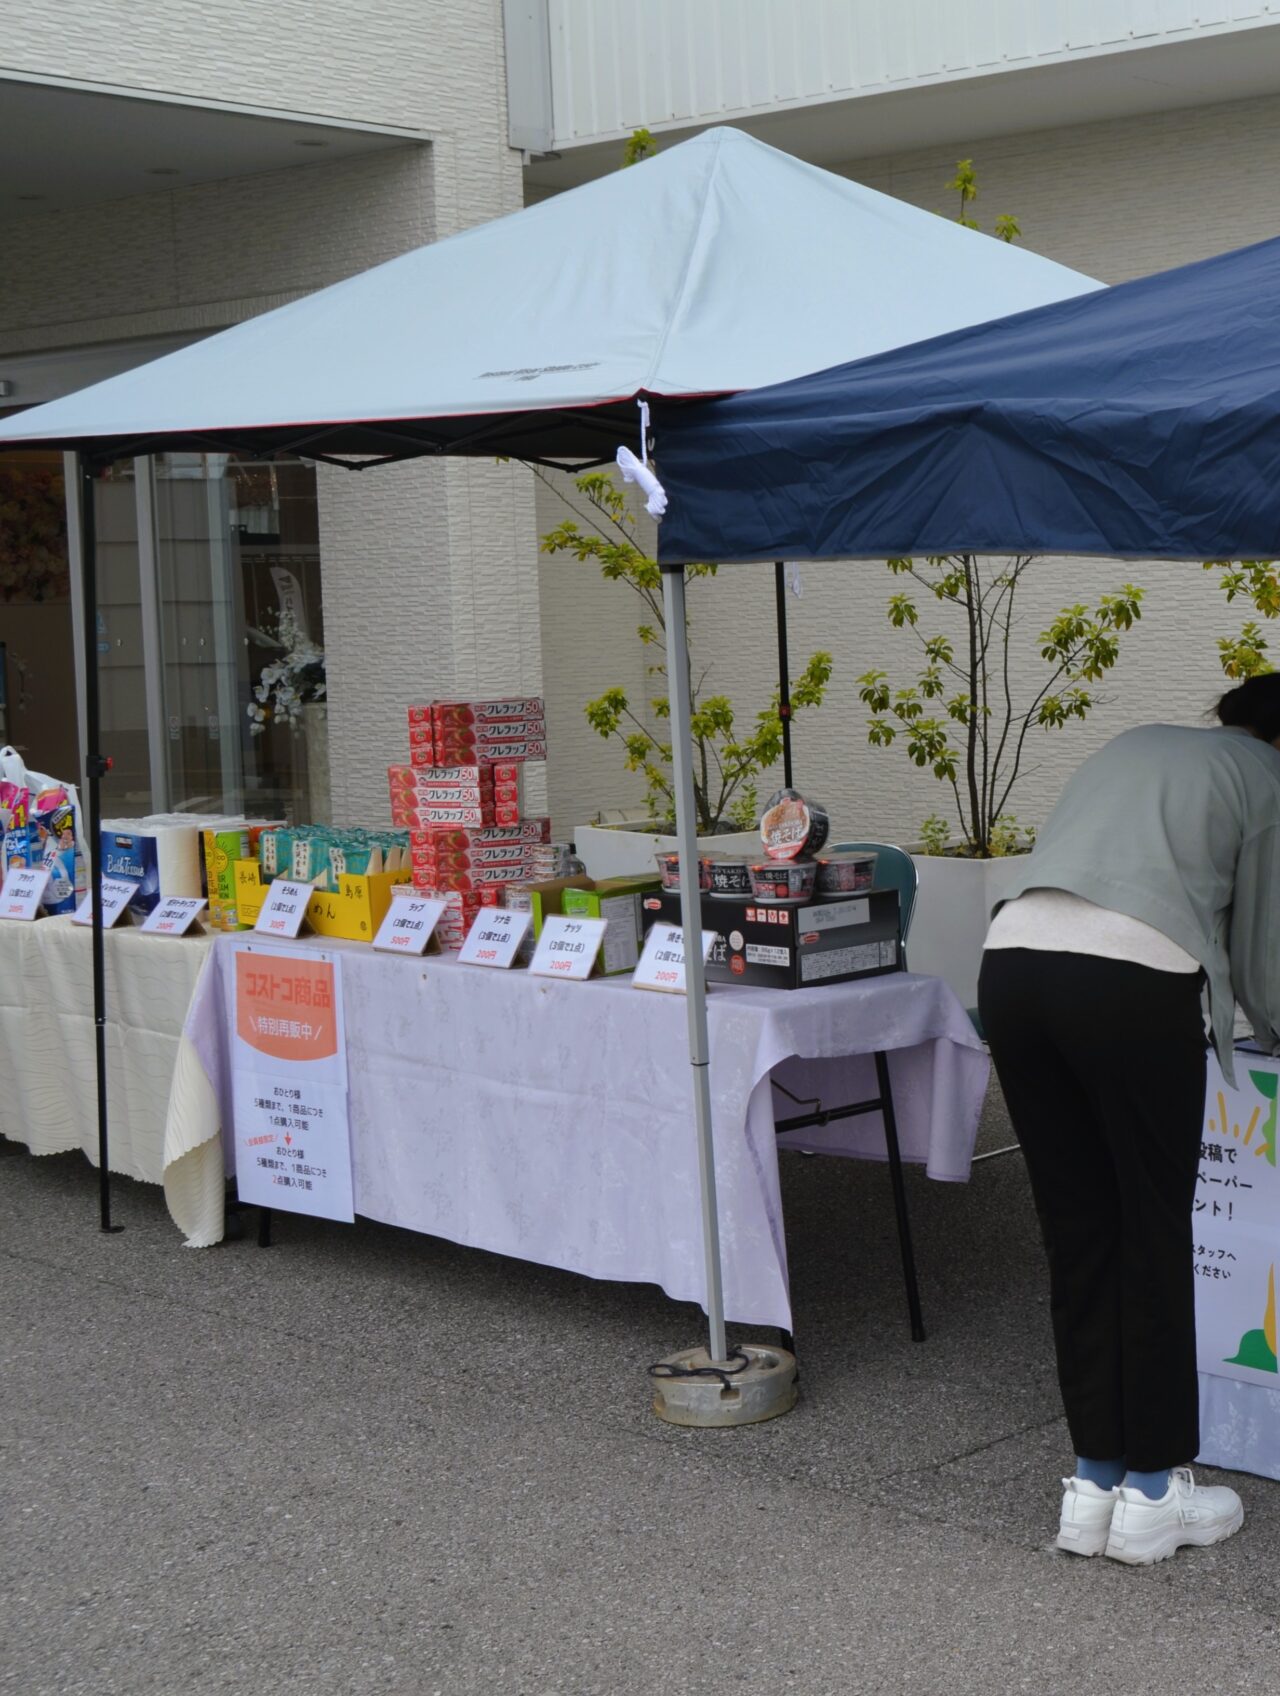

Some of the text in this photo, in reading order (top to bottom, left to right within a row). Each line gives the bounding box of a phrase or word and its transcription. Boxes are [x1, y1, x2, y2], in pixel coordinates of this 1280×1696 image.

[487, 703, 524, 714] クレラップ
[489, 724, 526, 735] クレラップ
[489, 744, 527, 755] クレラップ
[427, 768, 473, 780] クレラップ 50
[429, 789, 474, 800] クレラップ 50
[430, 810, 476, 820] クレラップ 50
[483, 827, 522, 839] クレラップ
[484, 846, 523, 859] クレラップ
[107, 854, 144, 877] Bath Tissue
[485, 867, 524, 880] クレラップ
[408, 903, 425, 912] ラップ
[392, 918, 424, 930] (3個で1点)
[493, 915, 512, 925] ツナ缶
[563, 924, 583, 933] ナッツ
[478, 932, 511, 943] (3個で1点)
[549, 940, 585, 953] (3個で1点)
[476, 950, 497, 960] 200円
[550, 961, 572, 970] 200円
[655, 971, 678, 982] 200円
[245, 971, 331, 1009] コストコ商品
[257, 1016, 313, 1040] 特別再販中
[274, 1087, 302, 1100] おひとり様
[270, 1115, 310, 1131] 1点購入可能
[276, 1146, 305, 1160] おひとり様
[272, 1174, 313, 1191] 2点購入可能
[1192, 1244, 1238, 1261] タッフへ
